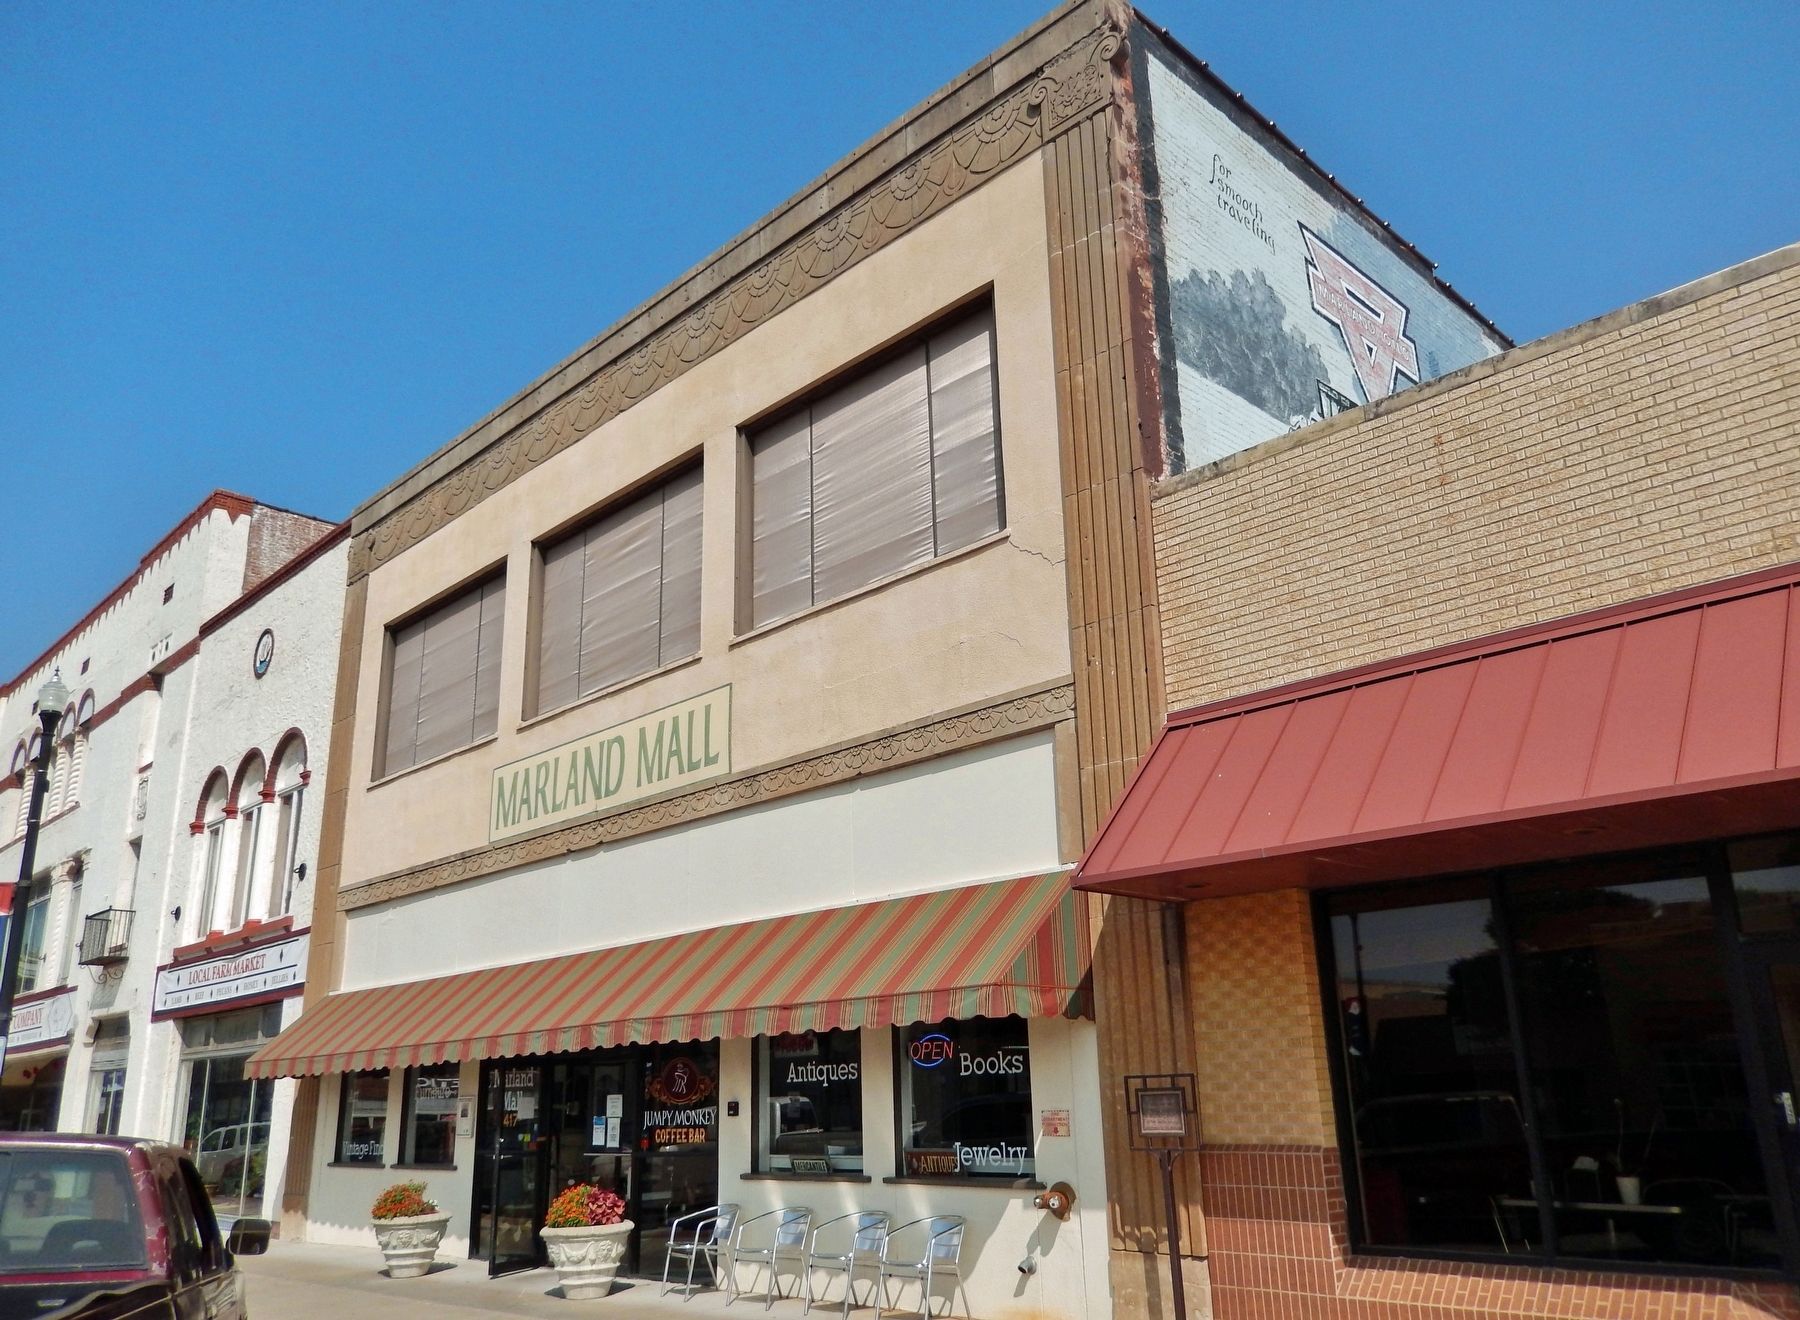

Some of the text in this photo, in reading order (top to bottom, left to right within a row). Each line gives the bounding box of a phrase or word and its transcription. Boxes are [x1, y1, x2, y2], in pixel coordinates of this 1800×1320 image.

[1209, 154, 1231, 184] for
[1218, 179, 1262, 223] smooth
[1218, 194, 1275, 256] traveling
[495, 703, 720, 831] MARLAND MALL
[188, 954, 267, 985] LOCAL FARM MARKET
[910, 1041, 954, 1060] OPEN
[959, 1051, 1024, 1075] Books
[786, 1061, 858, 1086] Antiques
[503, 1113, 518, 1127] 417
[643, 1108, 718, 1130] JUMPY MONKEY
[655, 1127, 706, 1143] COFFEE BAR
[343, 1142, 369, 1160] Vintage
[953, 1142, 1027, 1176] Jewelry
